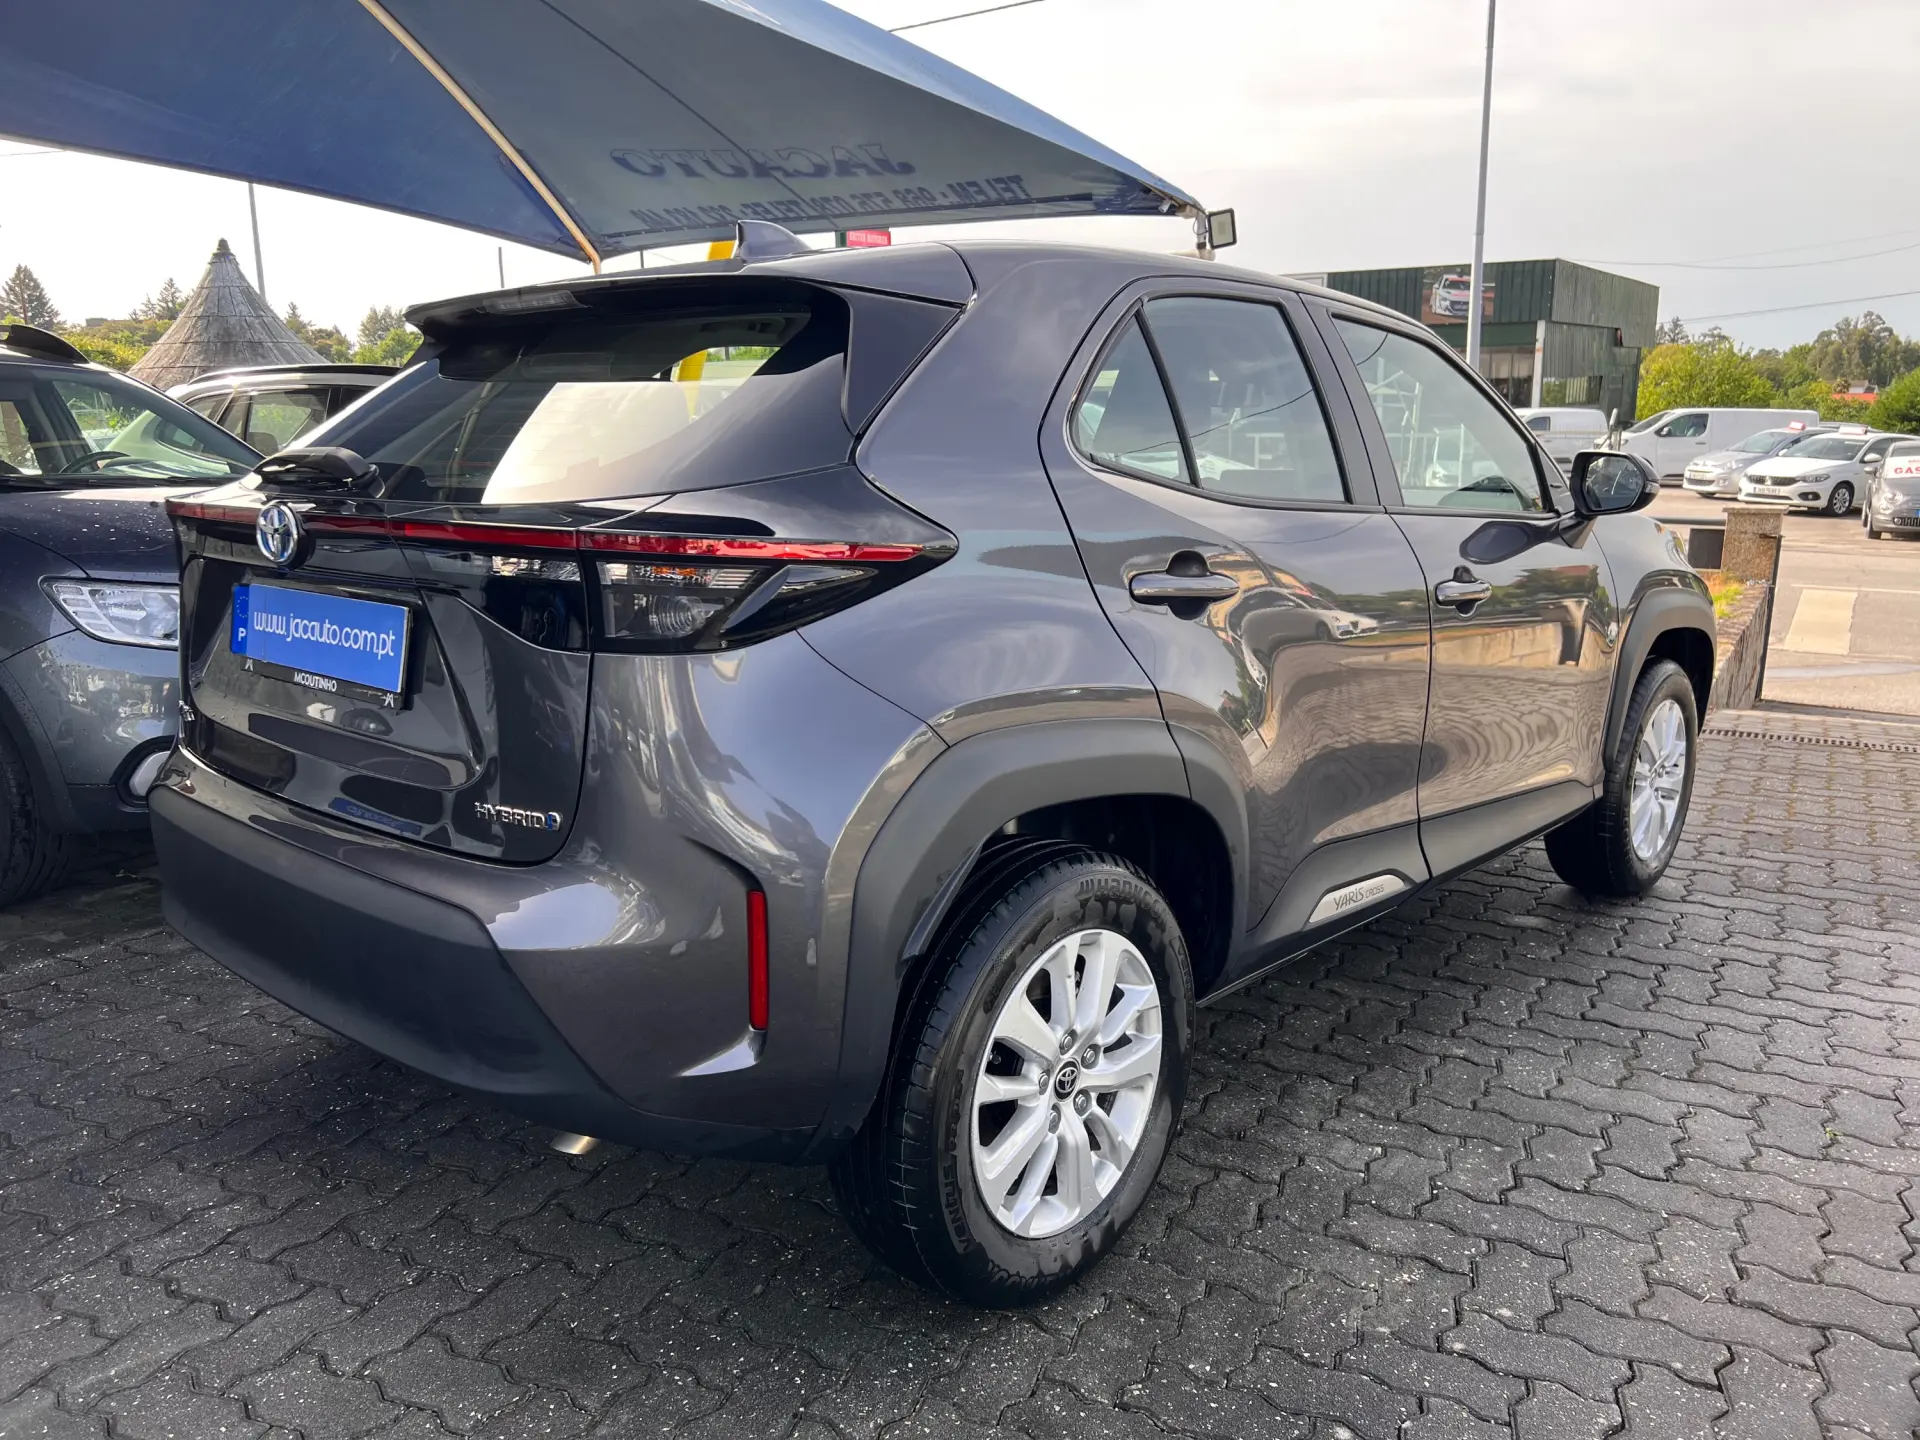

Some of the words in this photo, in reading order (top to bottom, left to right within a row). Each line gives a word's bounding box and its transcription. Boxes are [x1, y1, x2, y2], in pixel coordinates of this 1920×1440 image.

[238, 627, 247, 642] P
[253, 611, 396, 660] www.jacauto.com.pt
[293, 671, 338, 692] MCOUTINHO
[474, 801, 546, 830] HYBRID
[1365, 884, 1385, 899] CROSS
